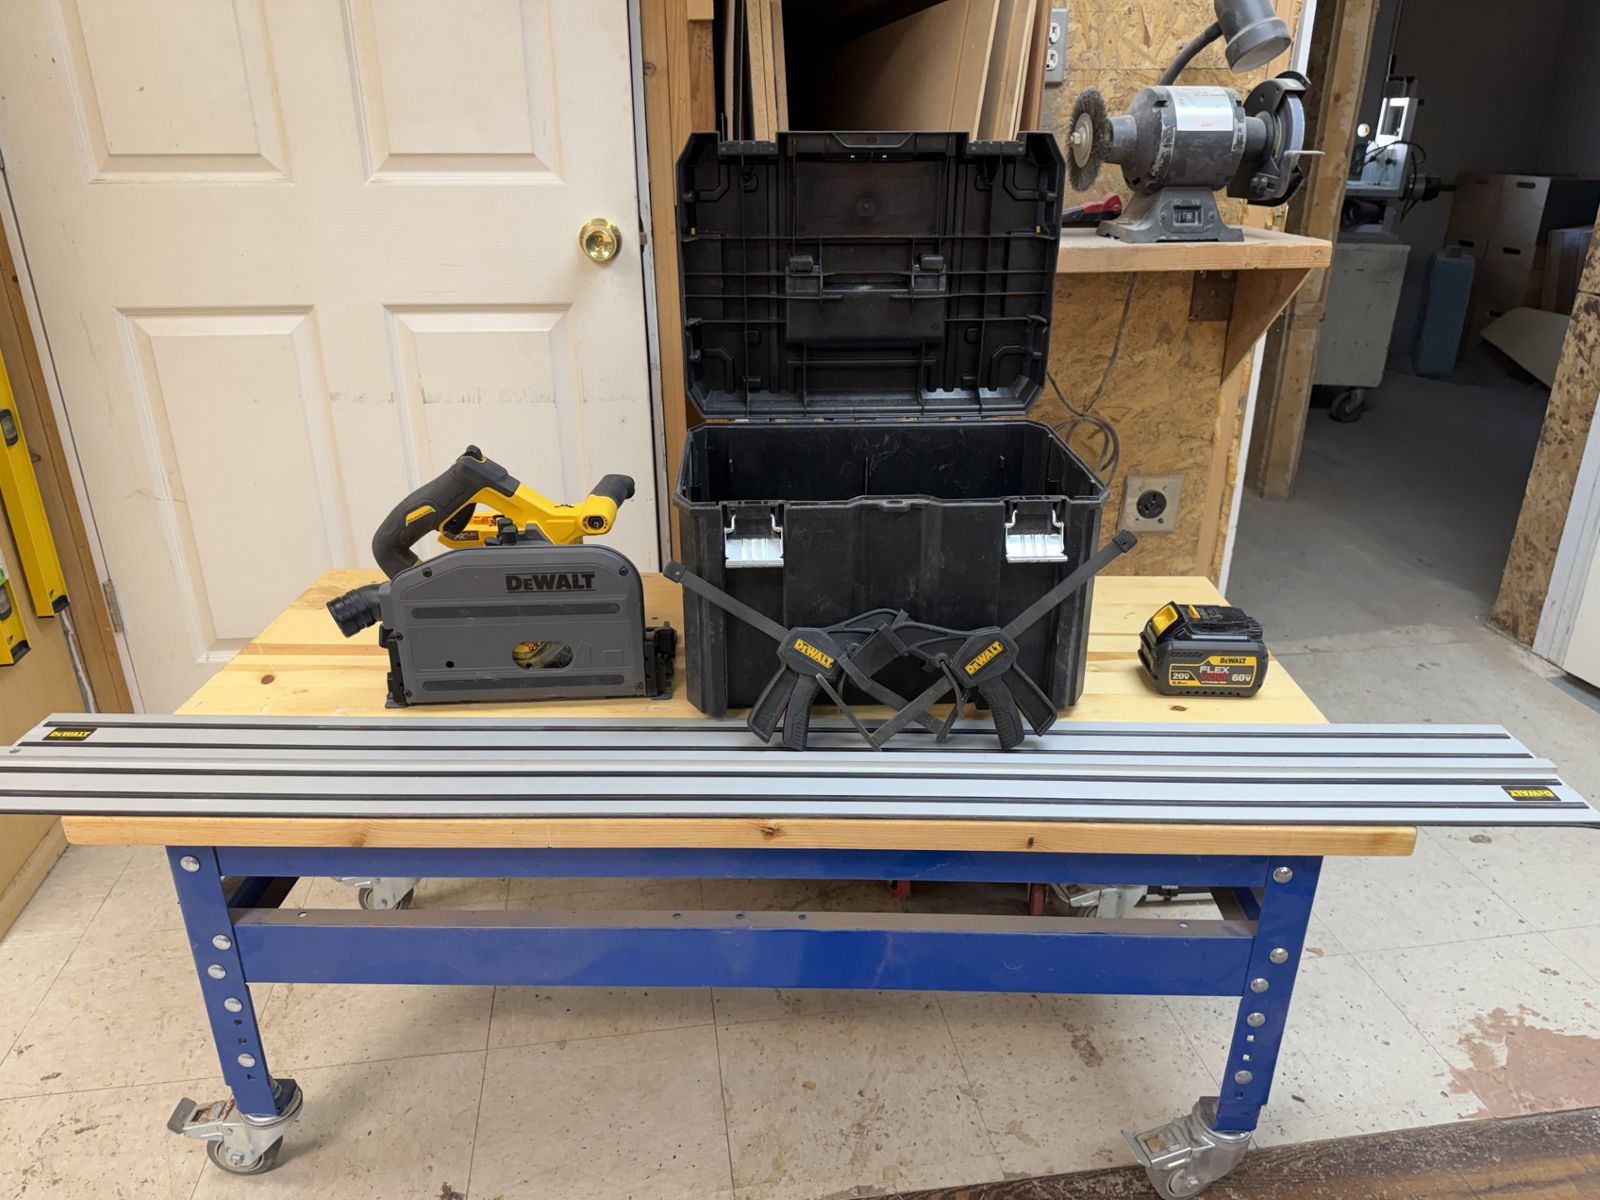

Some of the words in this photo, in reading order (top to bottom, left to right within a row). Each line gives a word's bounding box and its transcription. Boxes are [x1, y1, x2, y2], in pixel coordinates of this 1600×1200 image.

[1199, 665, 1231, 674] FLEX
[1172, 672, 1190, 680] 20V
[1231, 673, 1252, 682] 60V
